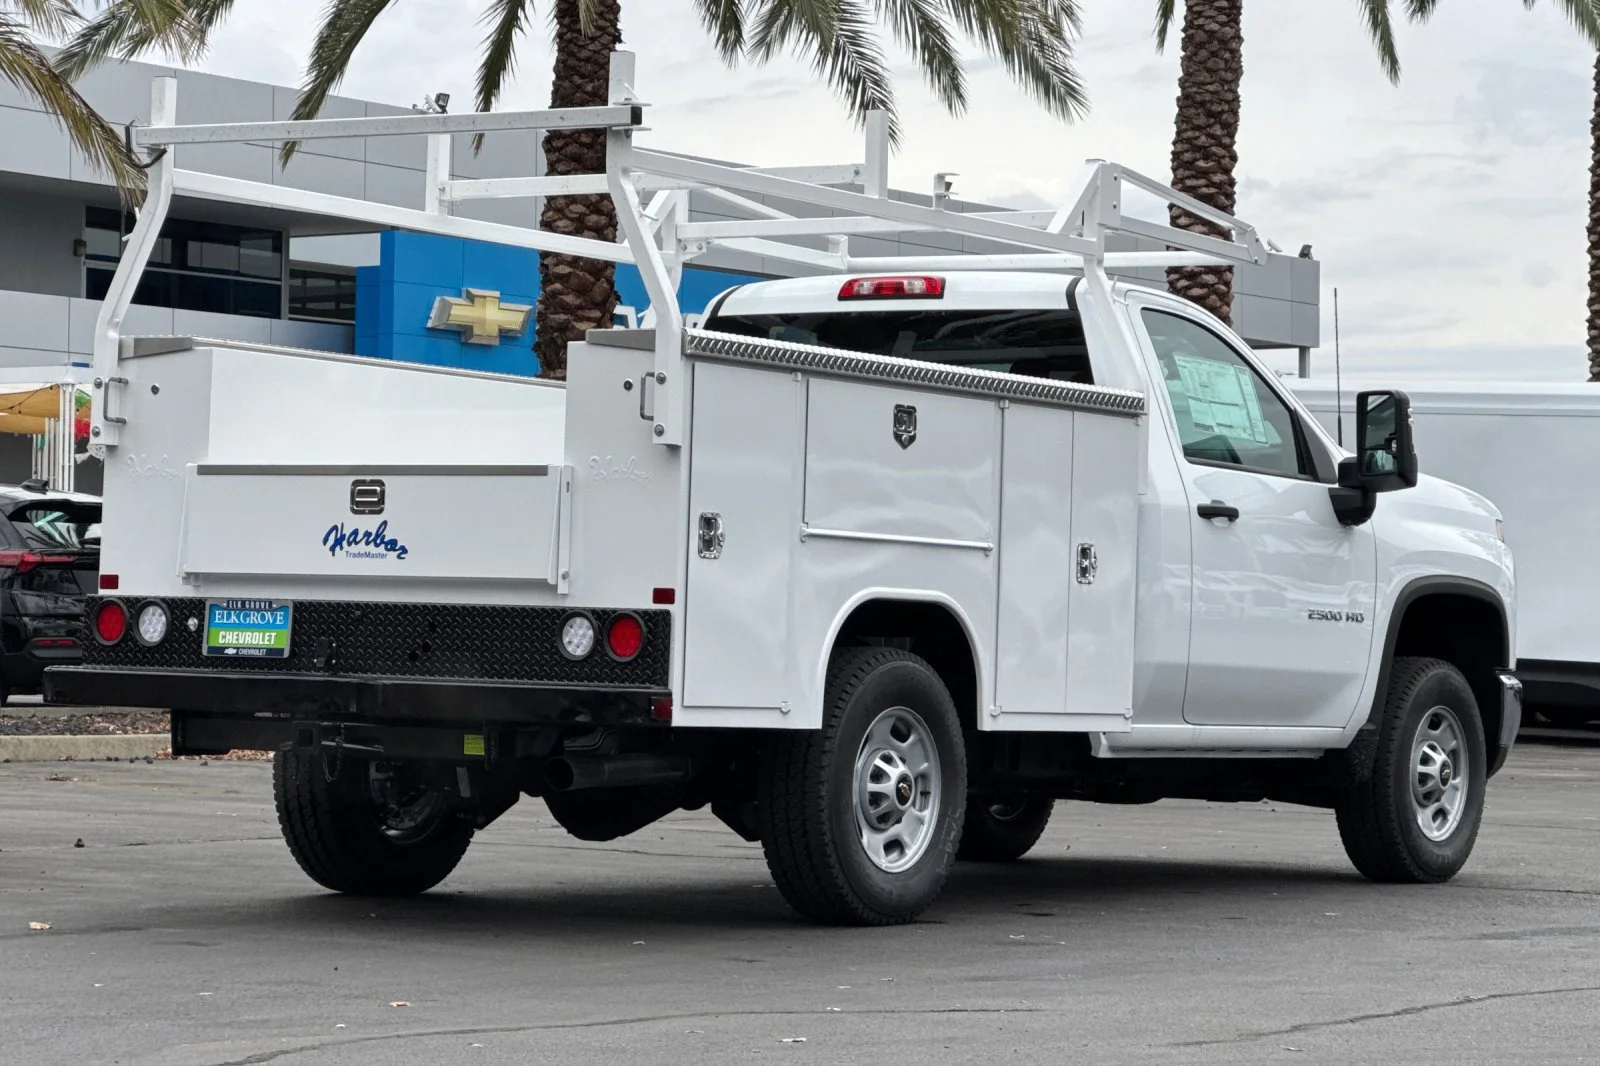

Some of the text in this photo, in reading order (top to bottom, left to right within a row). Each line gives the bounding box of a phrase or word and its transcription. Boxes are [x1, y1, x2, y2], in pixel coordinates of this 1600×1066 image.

[322, 519, 408, 560] Harbor
[345, 551, 388, 559] TradeMaster
[229, 600, 270, 609] ELK GROVE
[214, 610, 284, 624] ELK GROVE
[1308, 609, 1365, 623] 2500 HD
[219, 631, 277, 645] CHEVROLET
[238, 648, 267, 656] CHEVROLET
